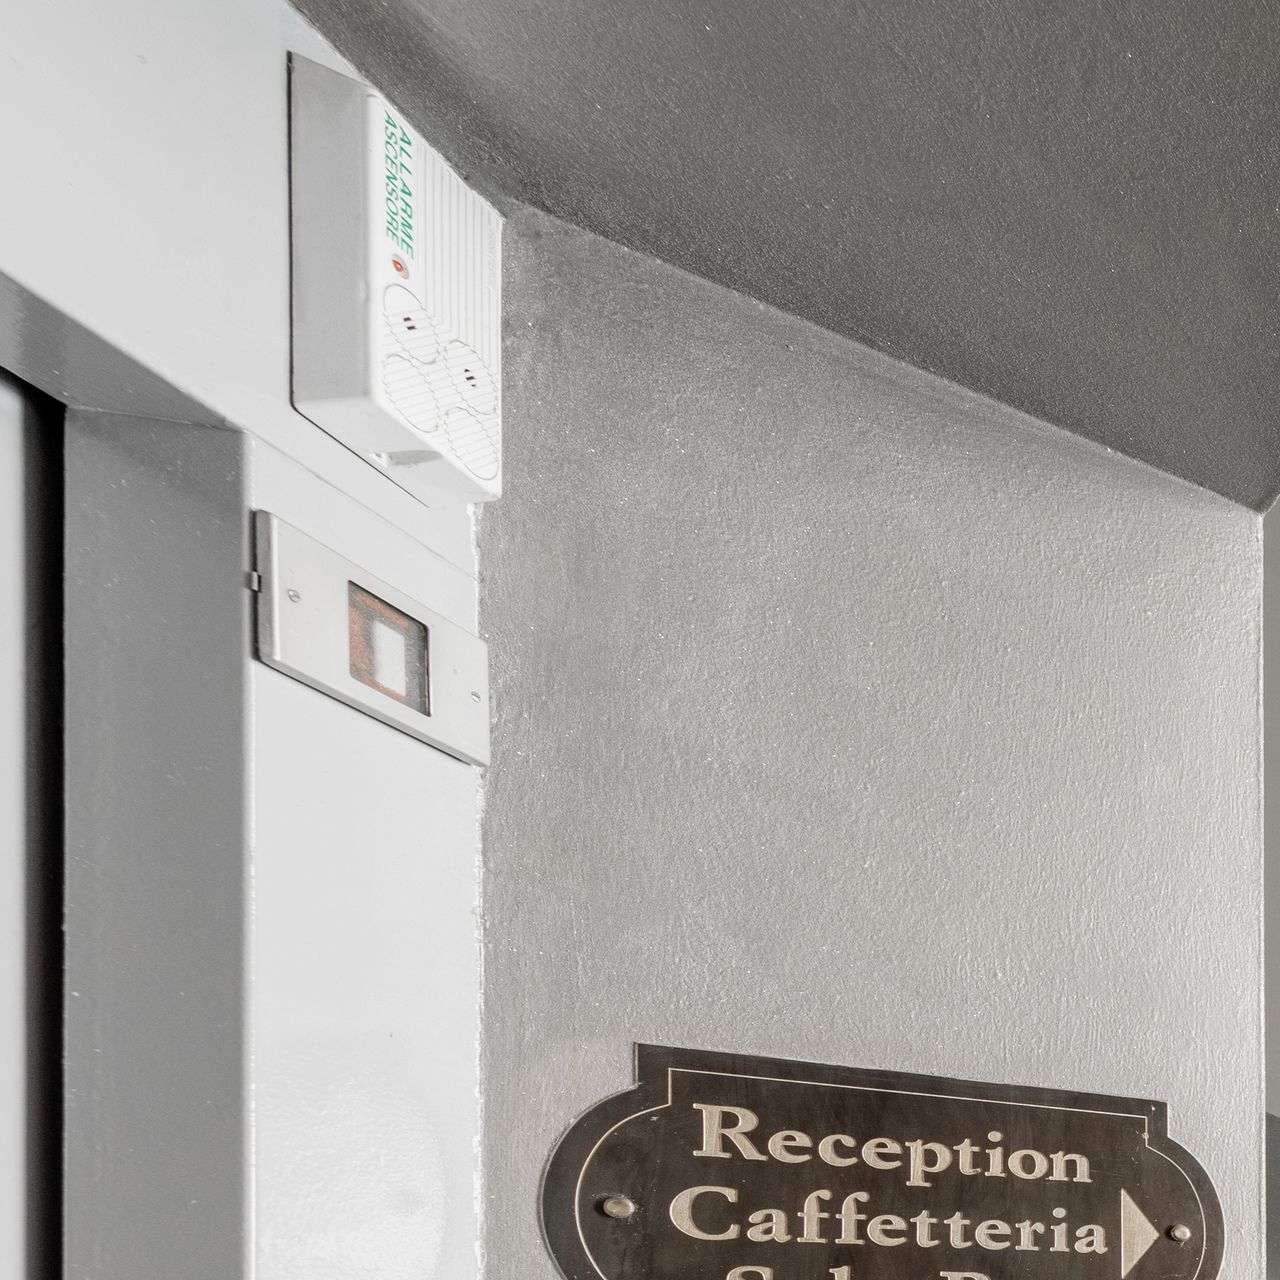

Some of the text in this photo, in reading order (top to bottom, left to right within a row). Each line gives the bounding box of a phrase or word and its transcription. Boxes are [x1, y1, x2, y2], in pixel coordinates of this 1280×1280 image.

[384, 109, 399, 247] ASCENSORE
[399, 125, 415, 261] ALLARME
[692, 1102, 1093, 1188] Reception
[668, 1185, 1108, 1255] Caffetteria
